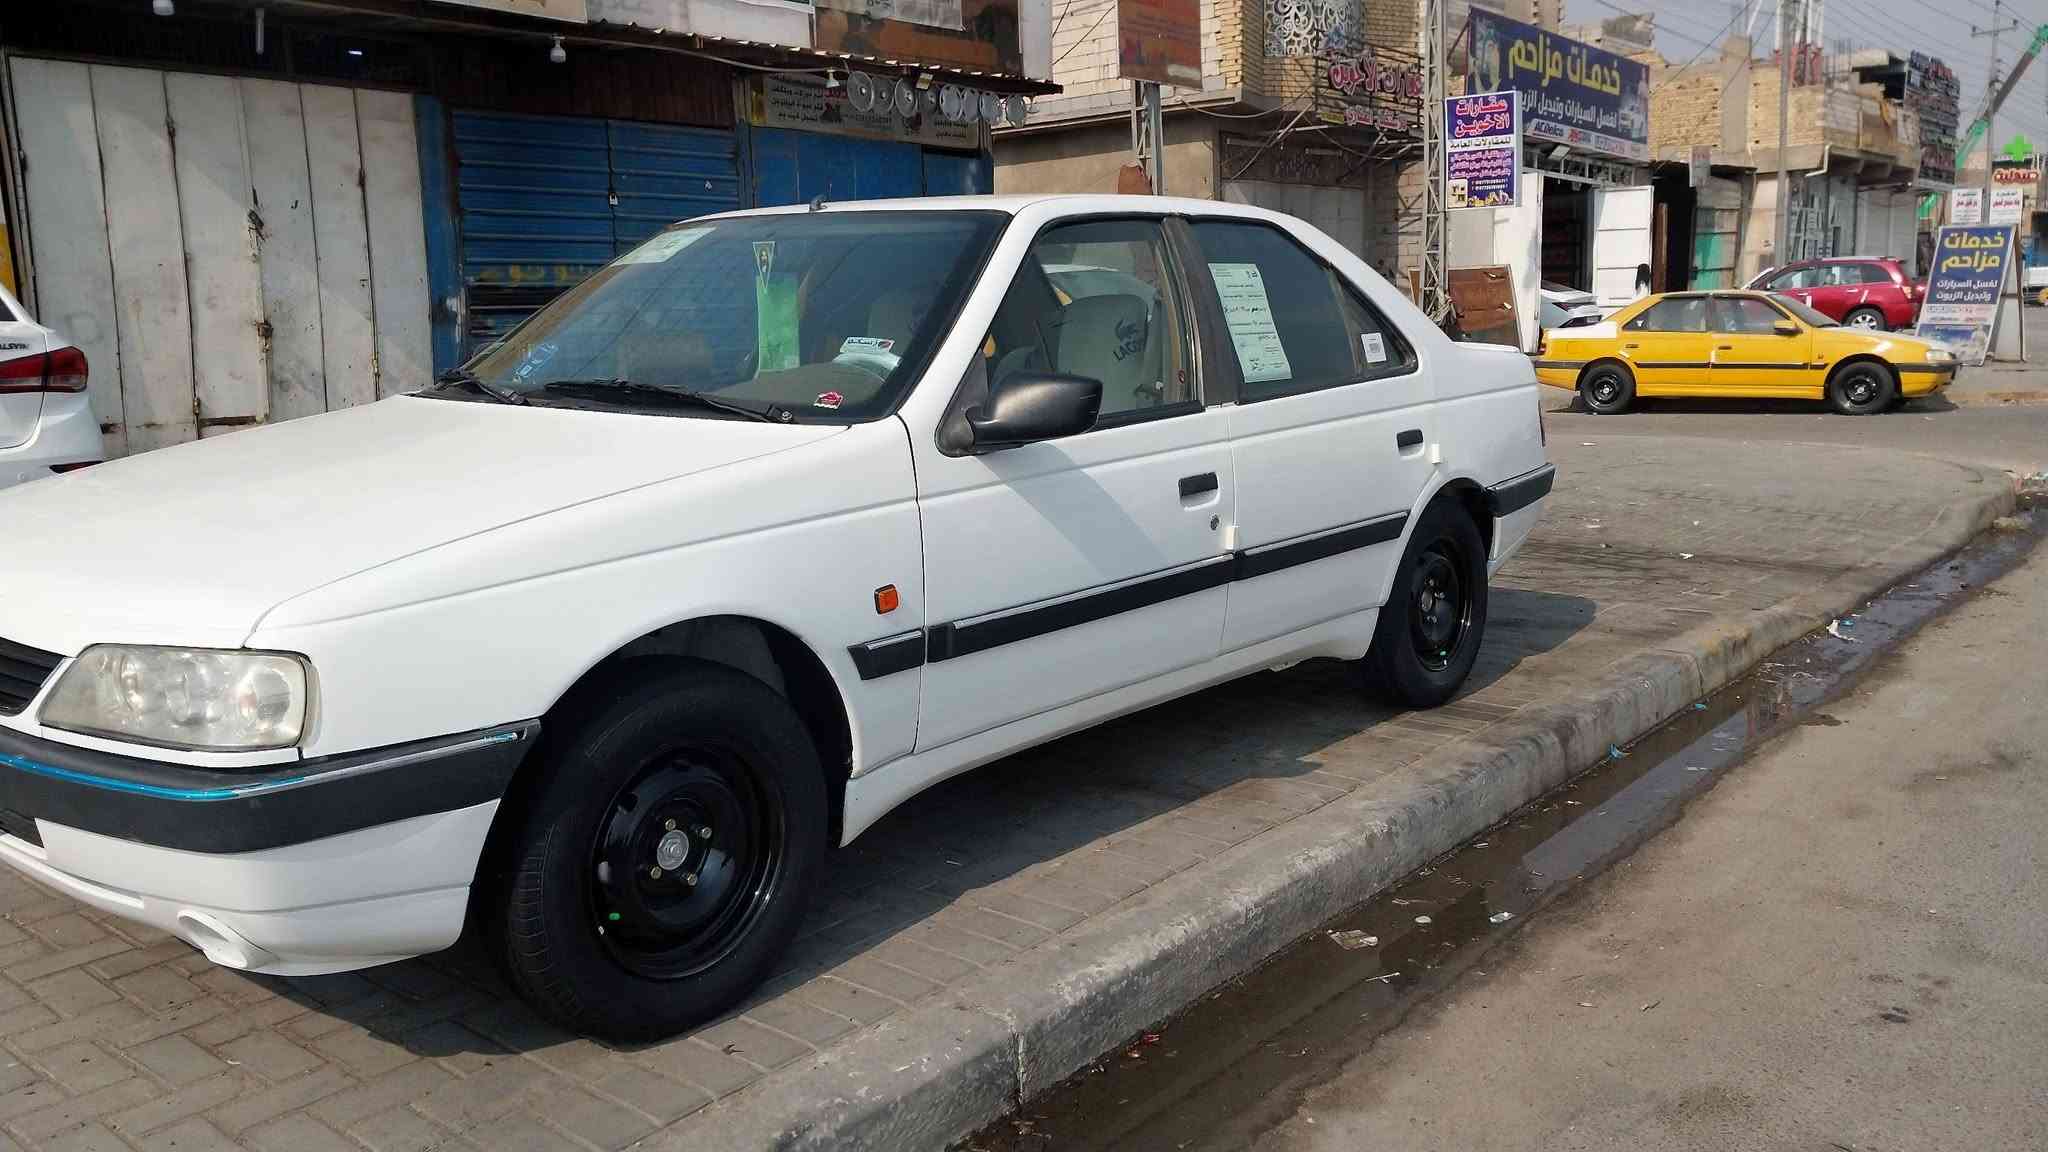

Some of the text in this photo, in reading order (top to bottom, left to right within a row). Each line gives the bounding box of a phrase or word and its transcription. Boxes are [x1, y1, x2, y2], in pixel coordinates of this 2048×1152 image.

[1508, 32, 1621, 96] خدمات مزاحم
[1537, 92, 1564, 120] وتبديل
[1564, 99, 1596, 125] السيارات
[1454, 112, 1510, 138] الاخوين
[1596, 107, 1617, 129] لغسل
[1993, 168, 2039, 185] صيدلية
[1944, 230, 2005, 249] خدمات
[1941, 250, 2000, 273] مزاحم
[1937, 279, 1998, 290] لغسل السيارات
[1936, 291, 1992, 302] وتبديل الزيوت
